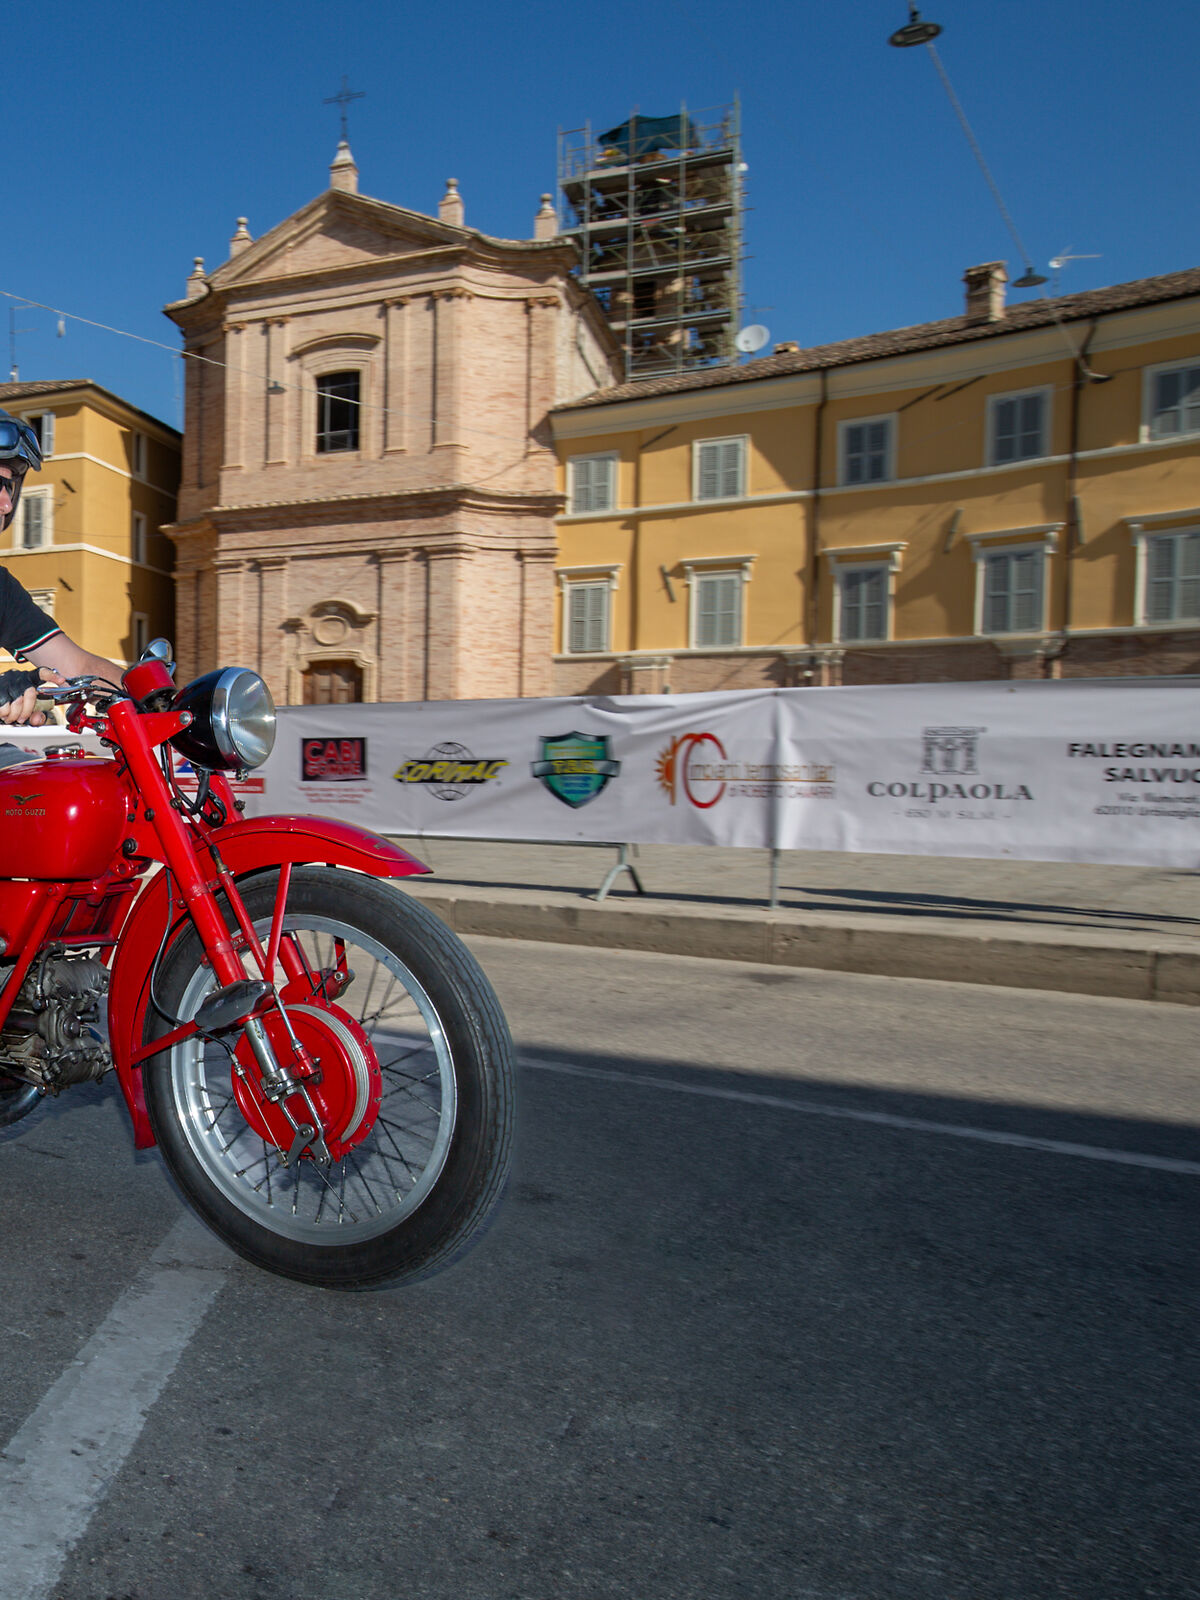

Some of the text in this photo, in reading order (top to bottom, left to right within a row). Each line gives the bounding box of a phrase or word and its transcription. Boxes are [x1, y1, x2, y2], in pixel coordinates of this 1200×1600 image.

[304, 740, 361, 763] CABI
[866, 781, 1035, 803] COLPAOLA
[5, 808, 46, 816] MOTO GUZZI
